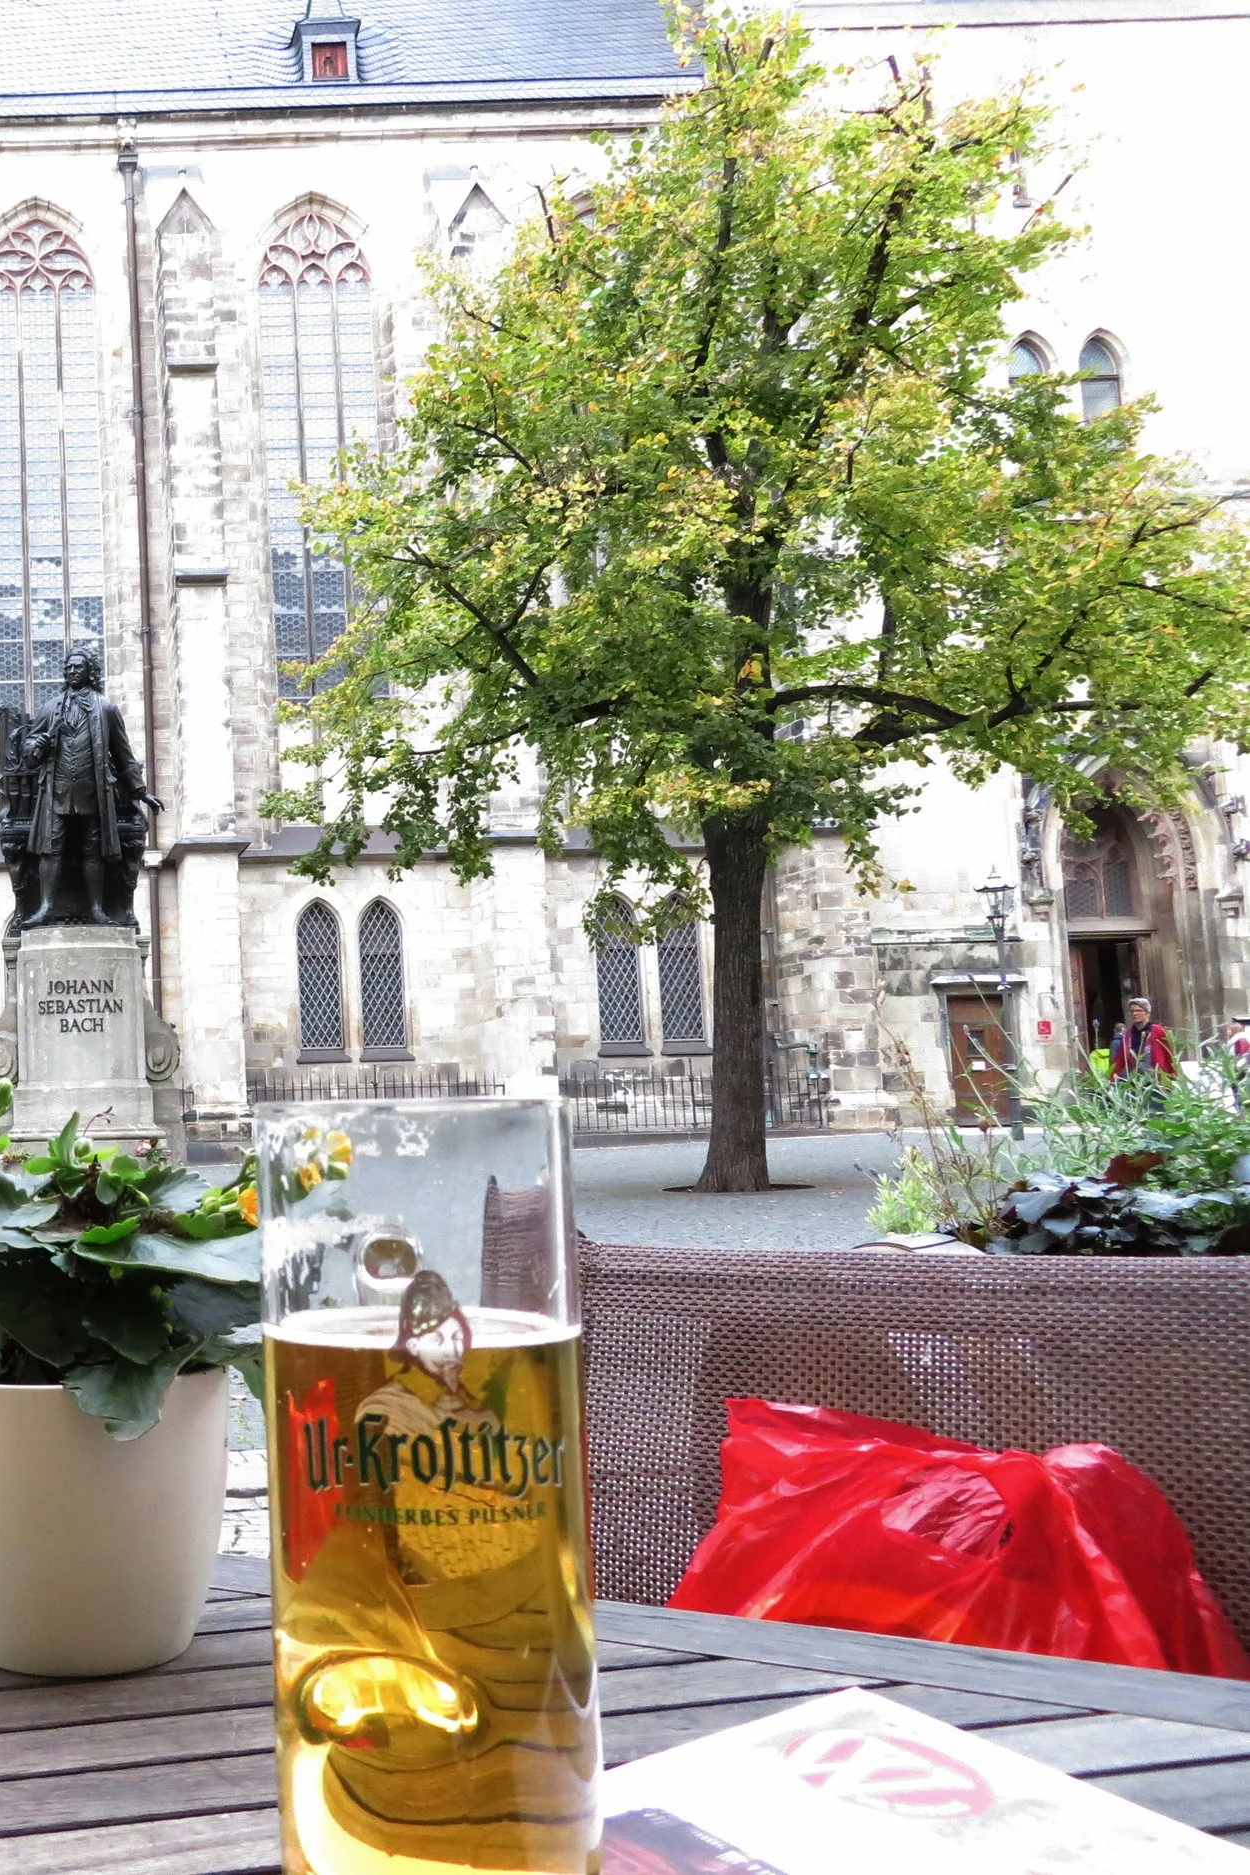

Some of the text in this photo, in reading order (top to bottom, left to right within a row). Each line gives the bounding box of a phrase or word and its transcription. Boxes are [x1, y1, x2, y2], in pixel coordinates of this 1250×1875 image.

[47, 979, 114, 995] JOHANN
[38, 998, 123, 1015] SEBASTIAN
[59, 1017, 104, 1033] BACH
[468, 1501, 547, 1525] PILSNER
